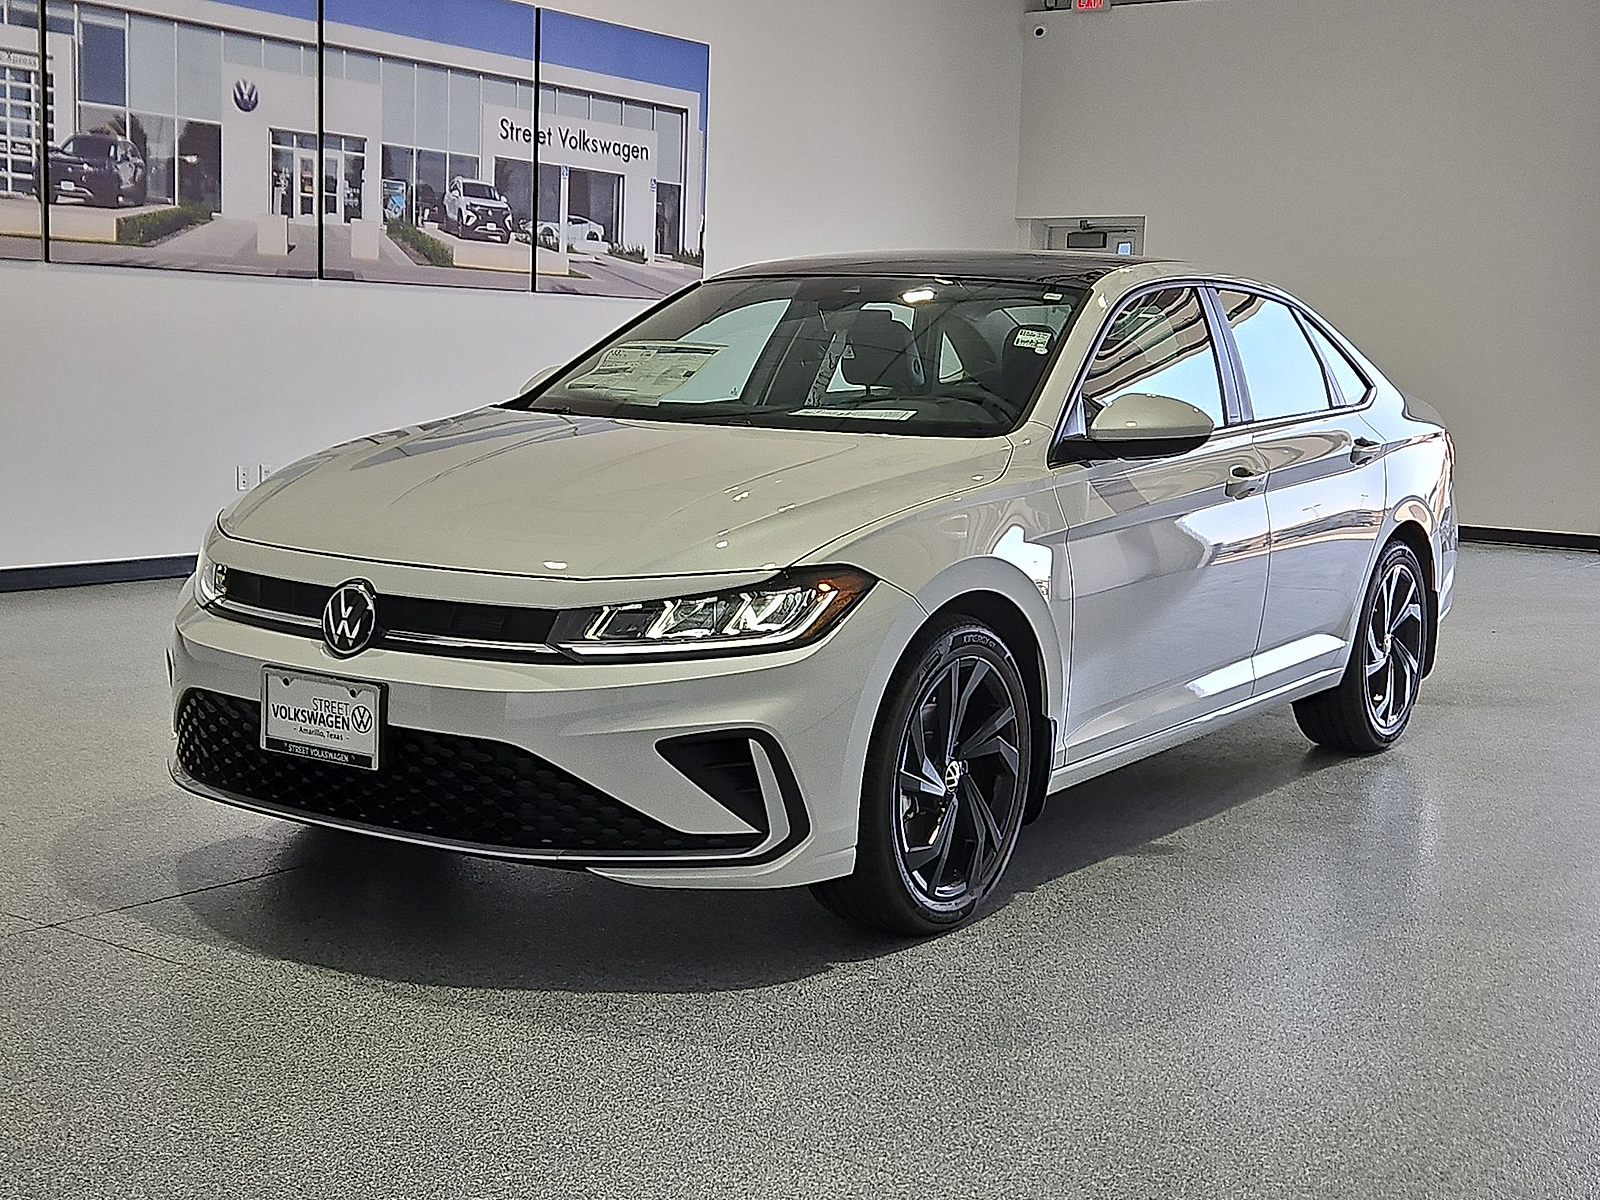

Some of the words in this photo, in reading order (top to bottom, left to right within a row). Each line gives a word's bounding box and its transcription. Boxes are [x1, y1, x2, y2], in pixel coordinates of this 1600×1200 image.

[499, 117, 552, 147] Street
[558, 126, 650, 162] Volkswagen
[312, 697, 350, 717] STREET
[271, 703, 350, 732] VOLKSWAGEN
[299, 726, 325, 739] Amarillo,
[326, 730, 344, 741] Texas
[288, 743, 310, 756] STREET
[310, 748, 350, 763] VOLKSWAGEN
